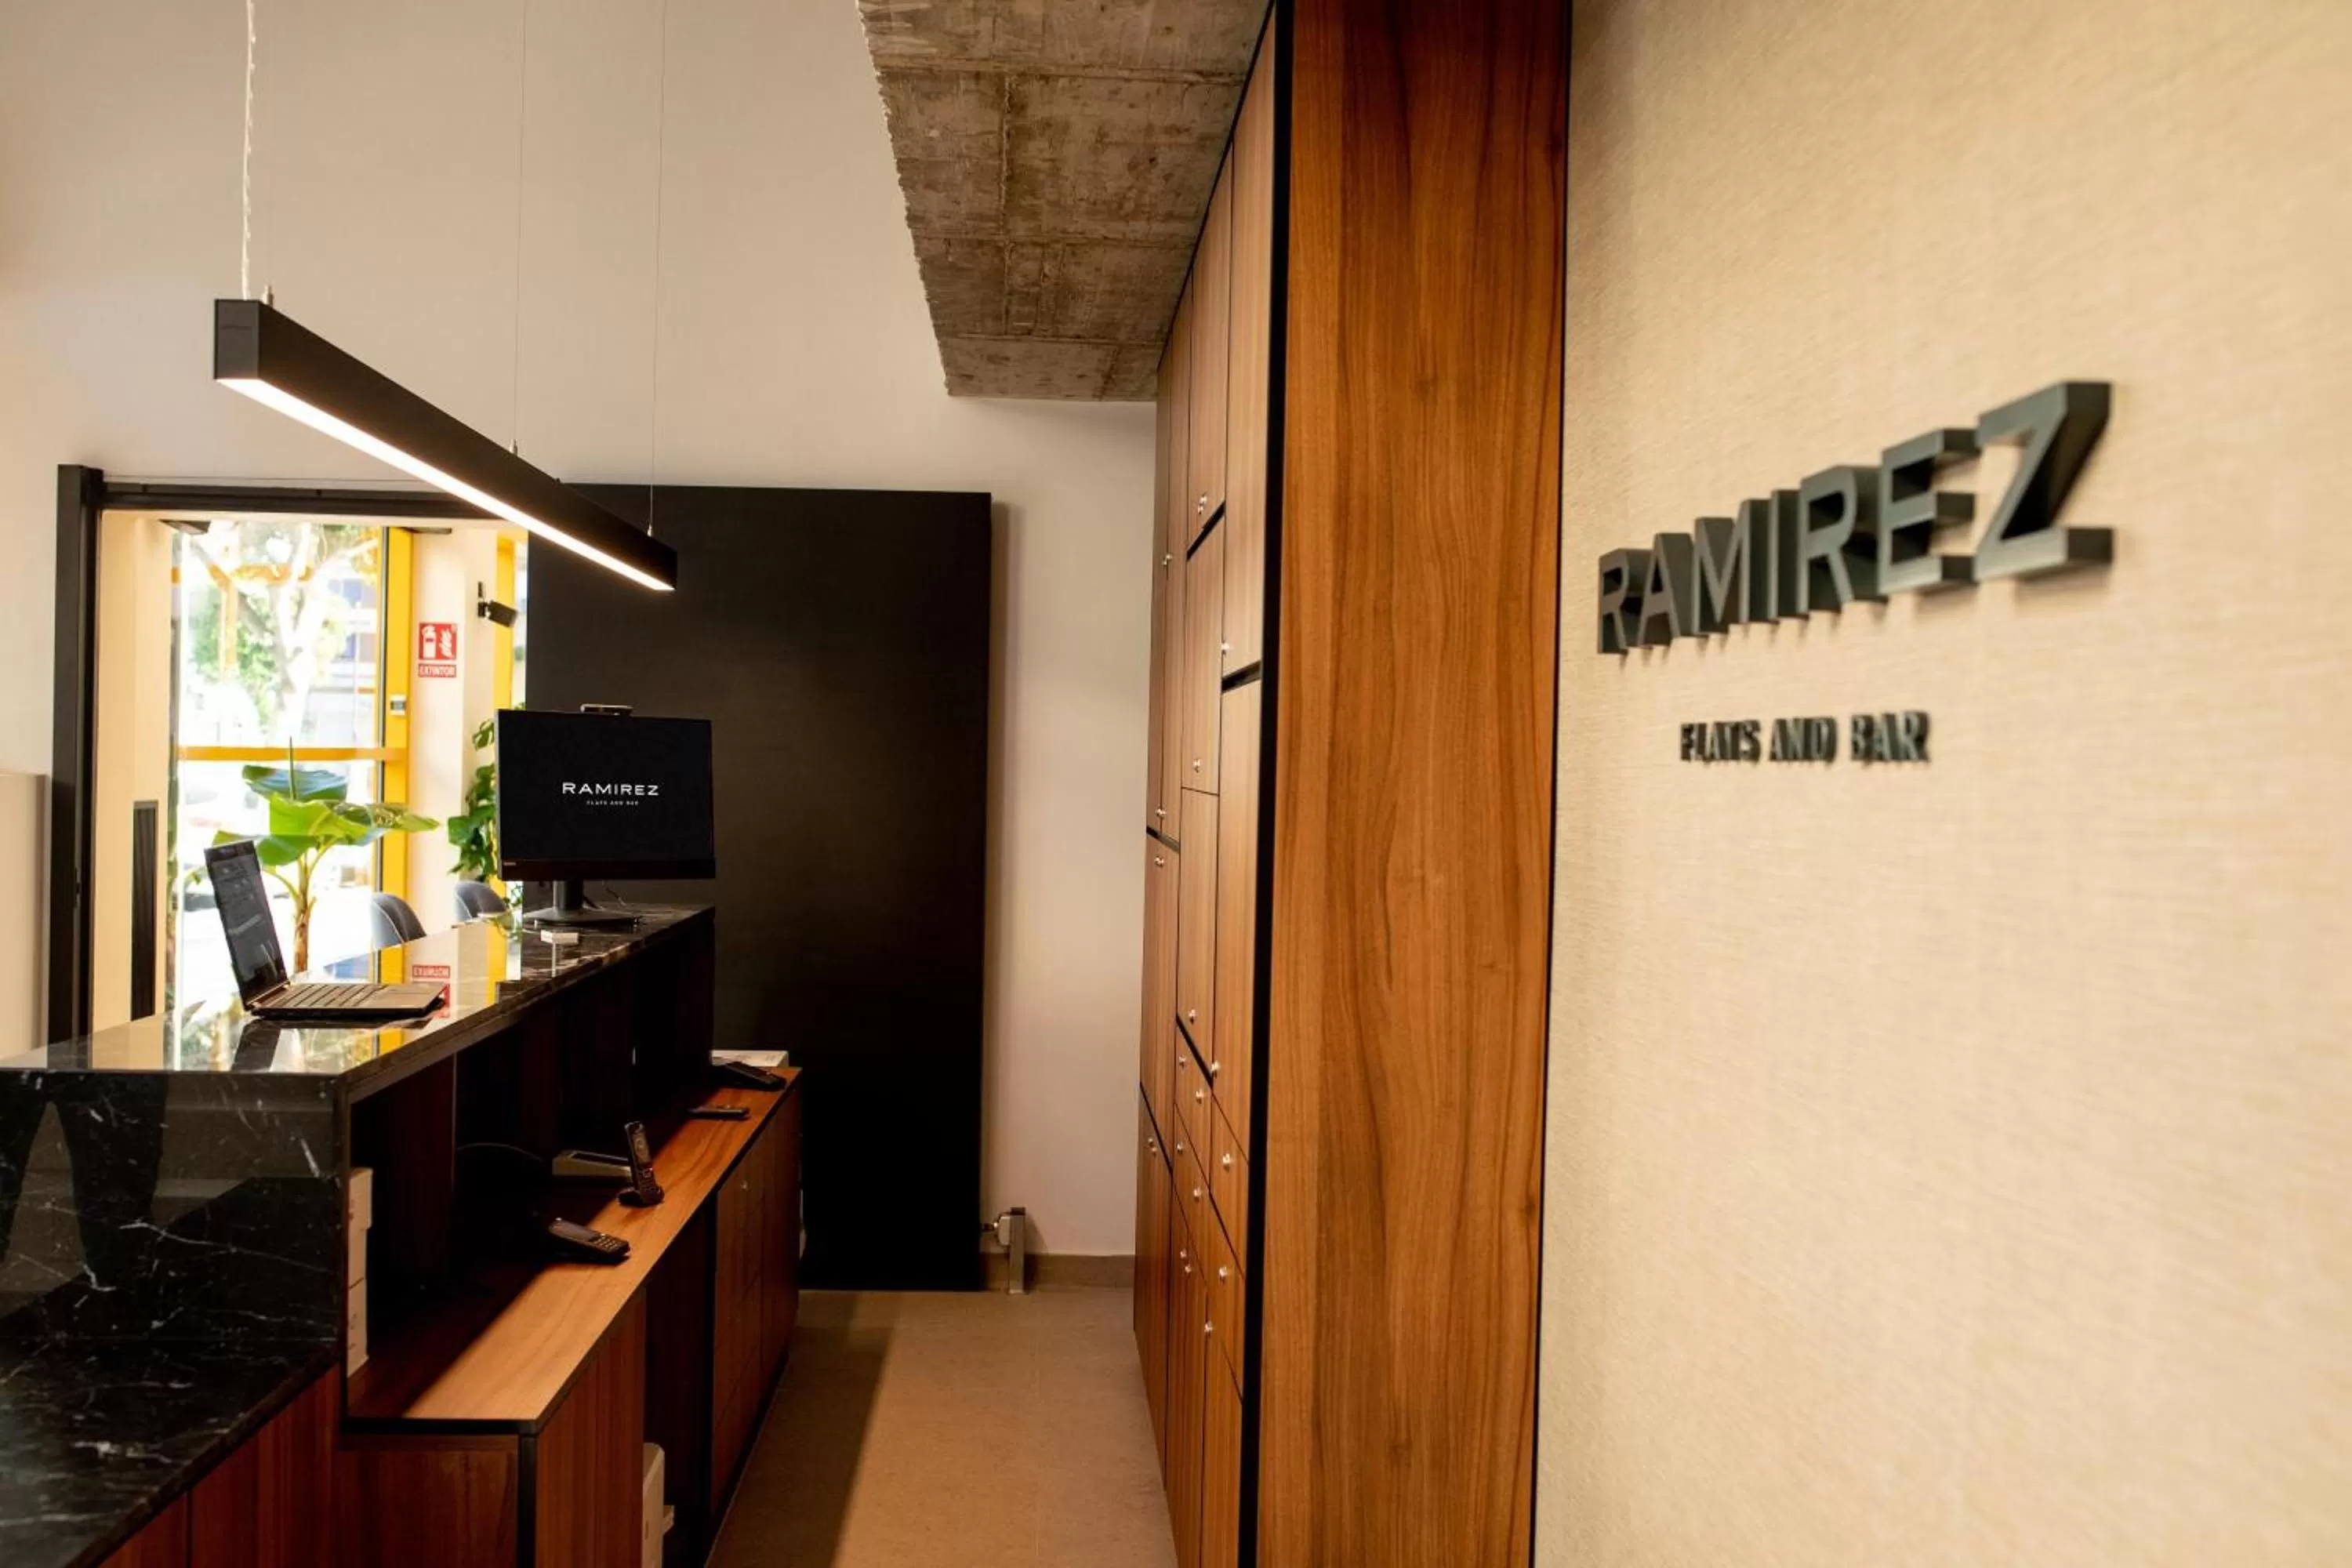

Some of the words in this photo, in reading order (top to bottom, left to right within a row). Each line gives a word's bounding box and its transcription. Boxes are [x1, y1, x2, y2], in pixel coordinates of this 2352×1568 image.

[1598, 381, 2114, 655] RAMIREZ
[1680, 719, 1762, 763] FLATS
[1769, 716, 1838, 764] AND
[1849, 710, 1930, 764] BAR
[561, 782, 659, 796] RAMIREZ
